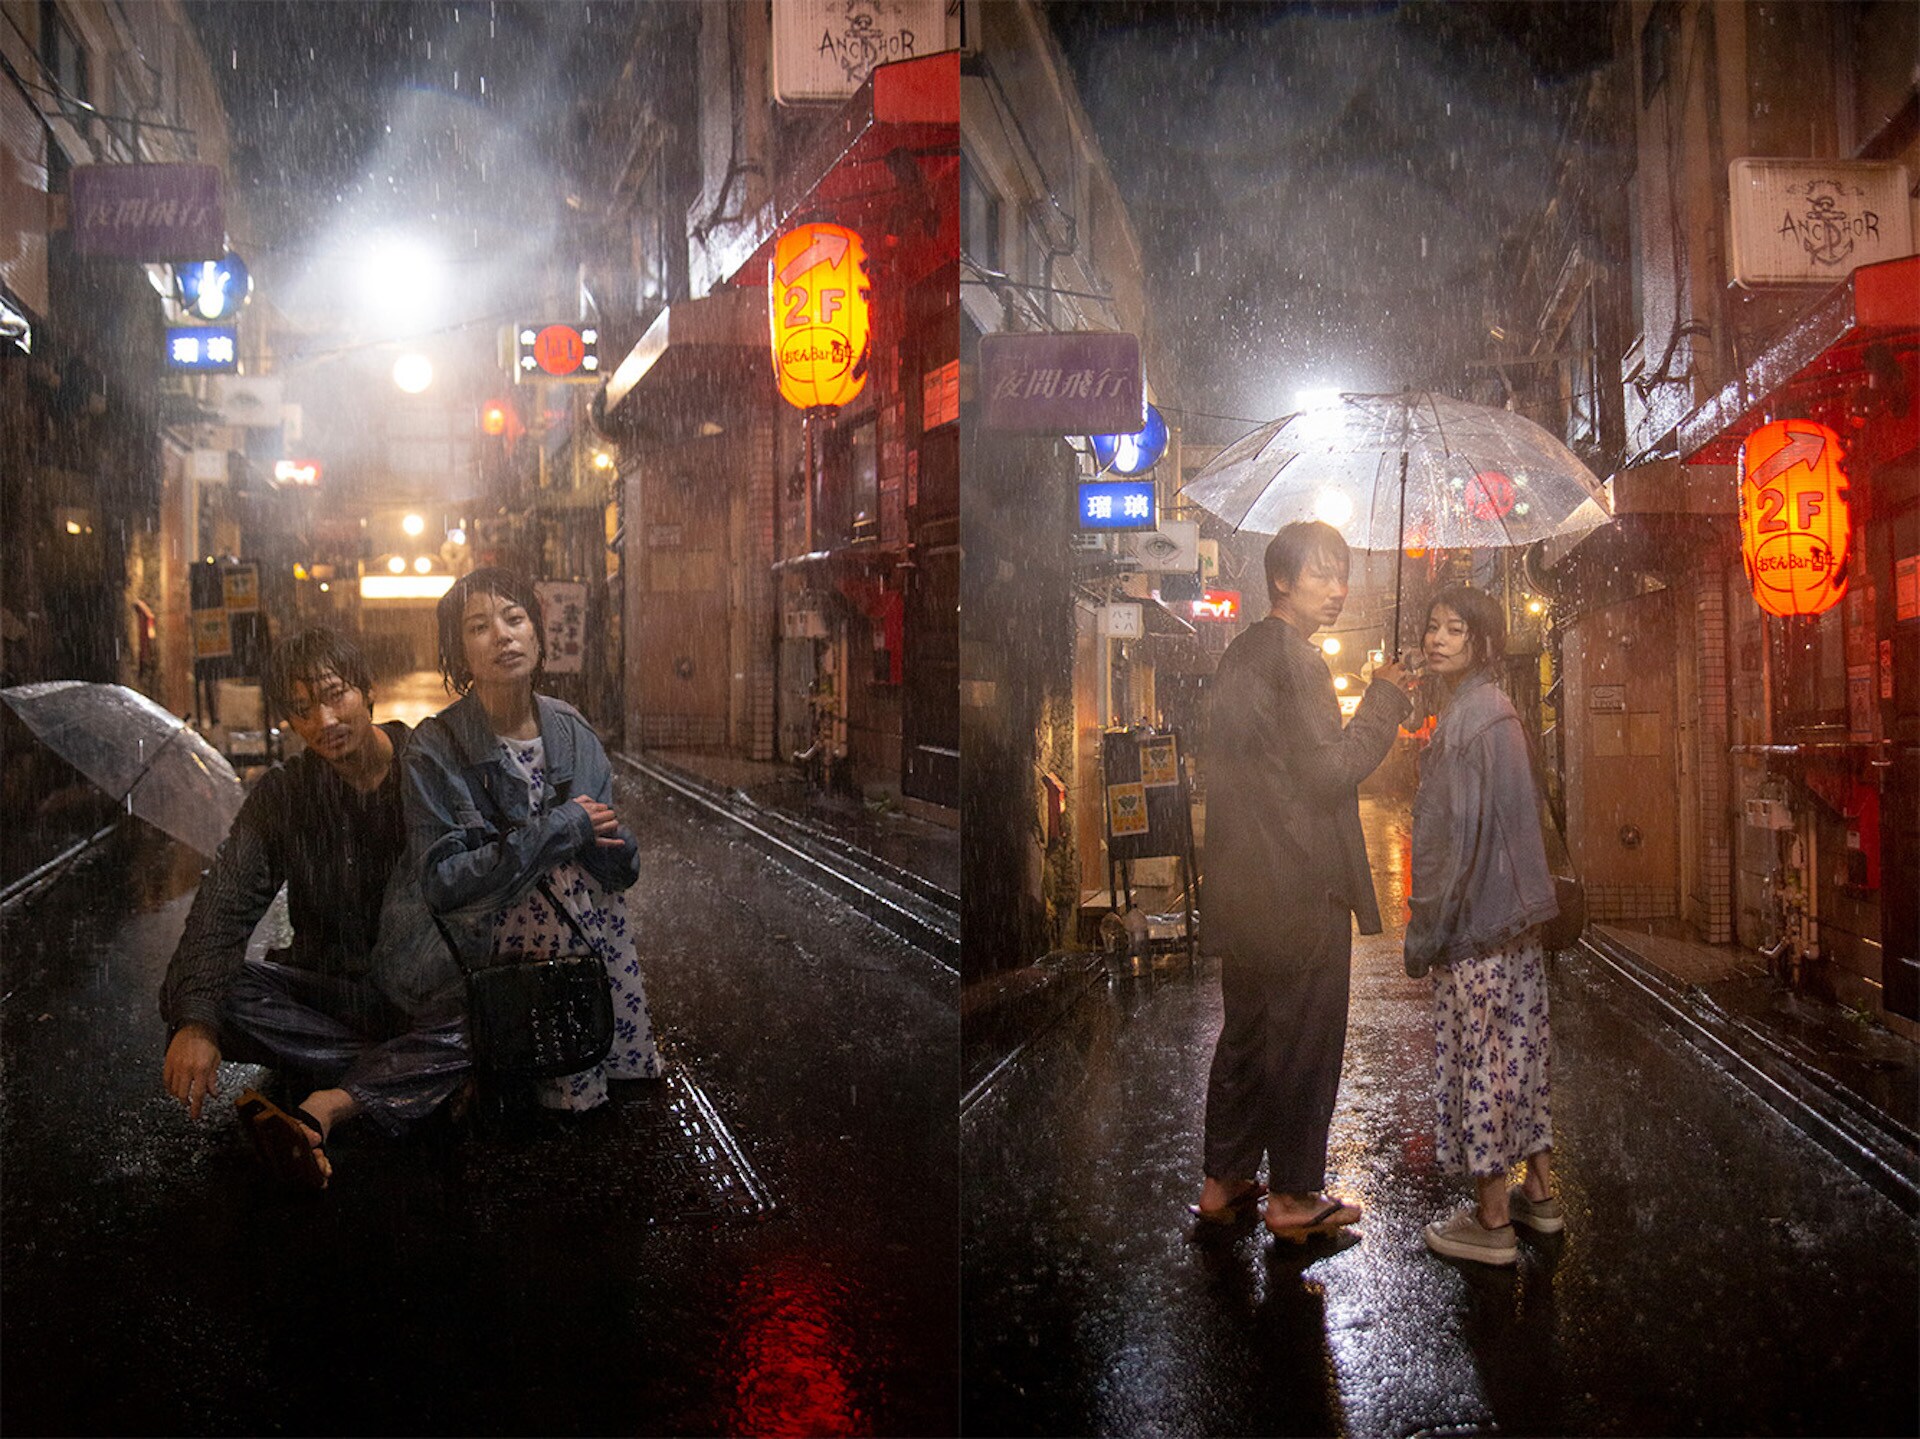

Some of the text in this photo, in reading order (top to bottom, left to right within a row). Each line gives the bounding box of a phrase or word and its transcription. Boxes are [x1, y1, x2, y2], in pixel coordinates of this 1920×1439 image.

[784, 286, 846, 329] 2F
[991, 367, 1129, 399] 夜間飛行
[1757, 488, 1824, 534] 2F
